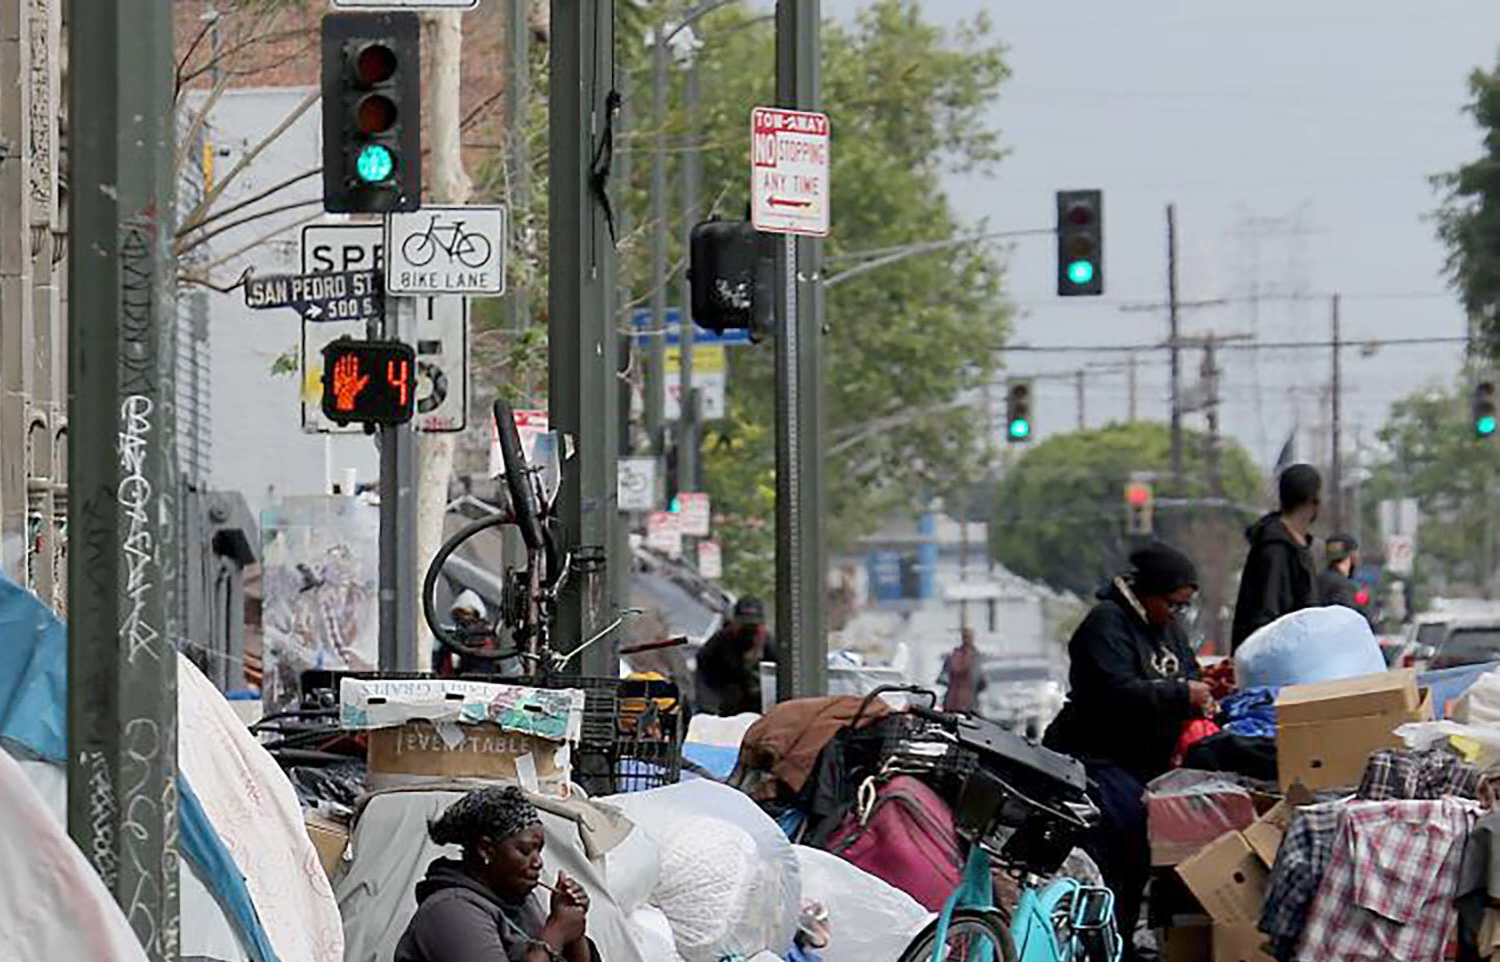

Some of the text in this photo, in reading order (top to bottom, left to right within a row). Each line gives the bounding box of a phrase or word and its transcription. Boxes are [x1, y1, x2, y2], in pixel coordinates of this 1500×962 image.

[756, 112, 825, 133] TOW-AWAY
[755, 132, 825, 165] NO STOPPING
[762, 172, 820, 196] ANY TIME
[250, 281, 288, 305] SAN
[292, 275, 347, 301] PEDRO
[401, 272, 487, 289] BIKE LANE
[328, 299, 358, 318] 500
[387, 360, 409, 406] 4
